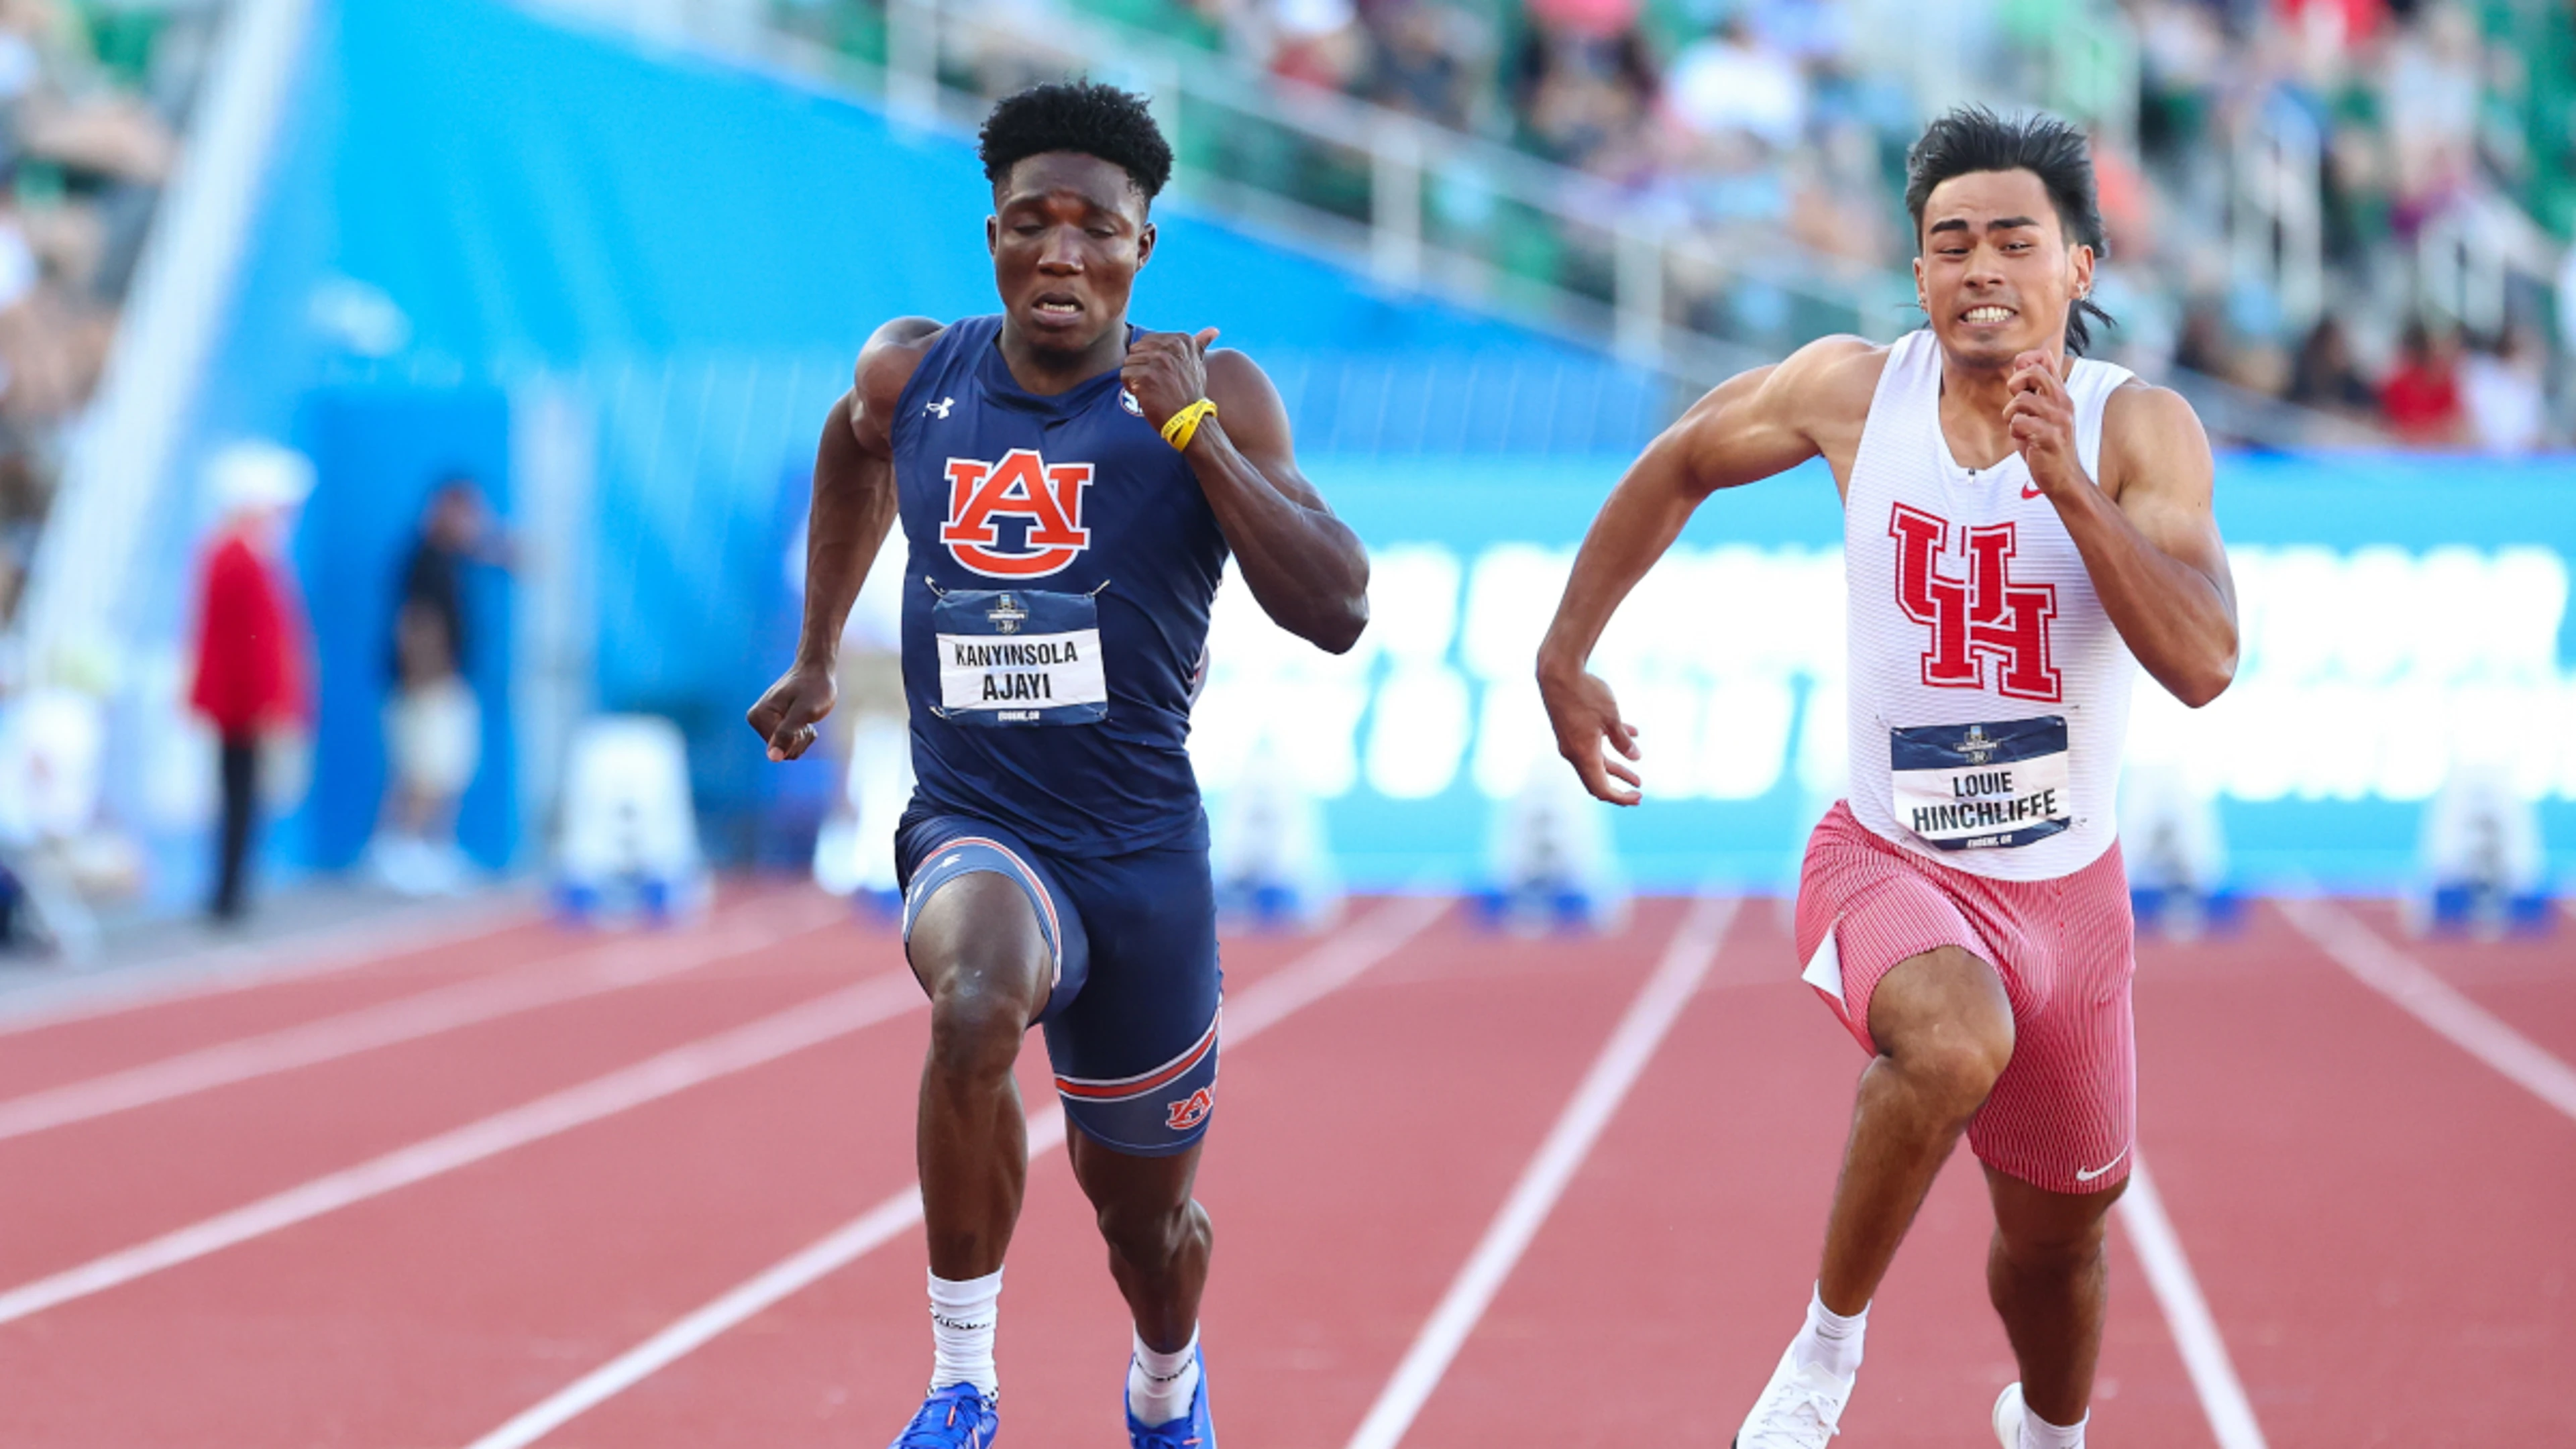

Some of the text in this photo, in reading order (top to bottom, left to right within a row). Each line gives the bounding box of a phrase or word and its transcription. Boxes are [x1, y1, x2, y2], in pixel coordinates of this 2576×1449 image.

[1888, 501, 2062, 703] UH
[955, 641, 1078, 667] KANYINSOLA
[983, 673, 1051, 700] AJAYI
[1953, 771, 2014, 797] LOUIE
[1912, 788, 2057, 832] HINCHLIFFE
